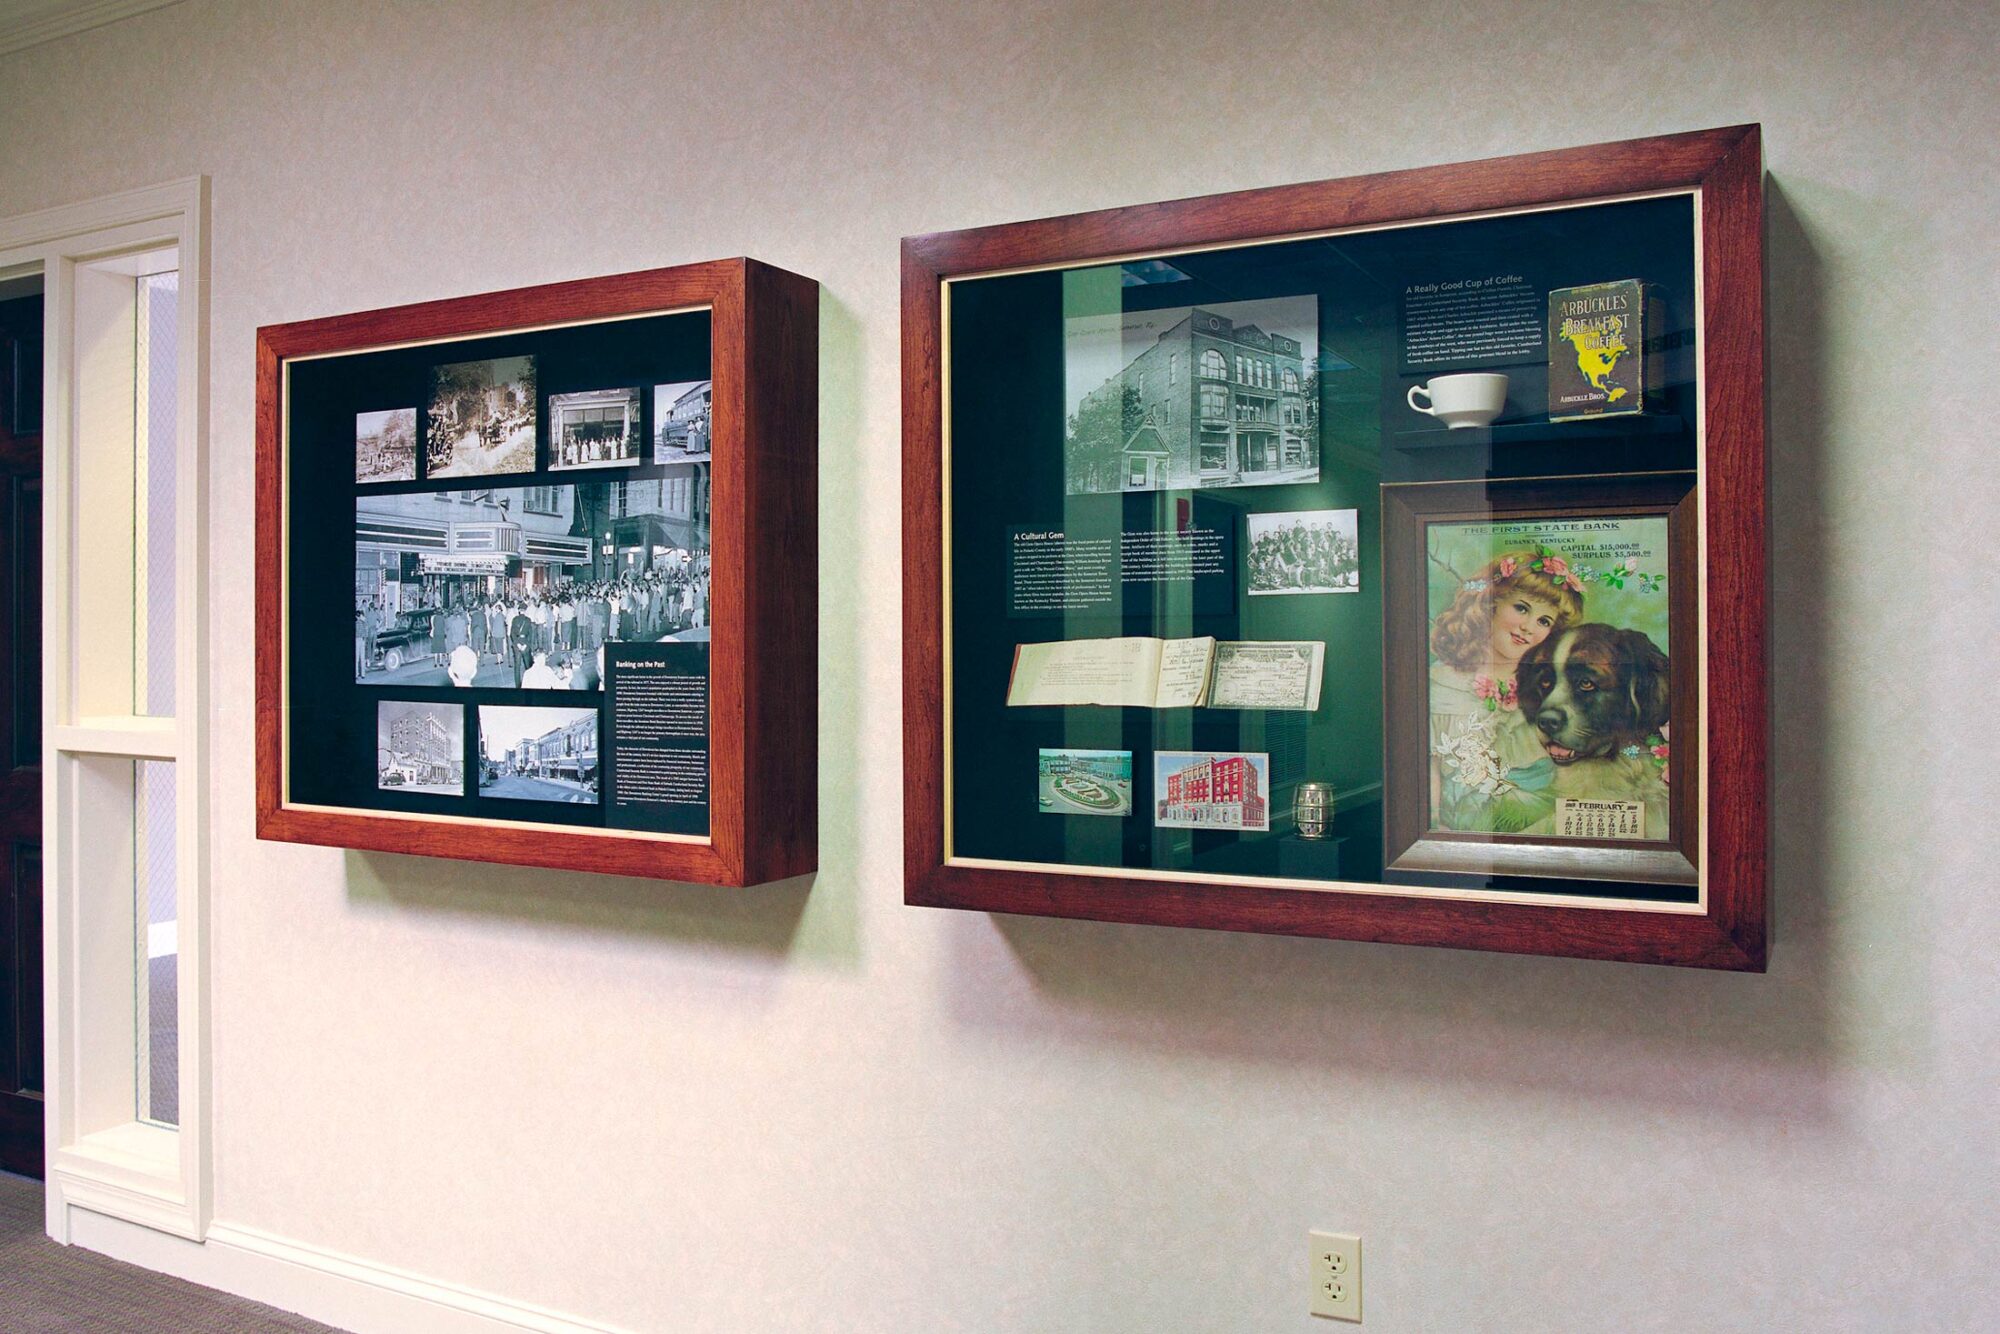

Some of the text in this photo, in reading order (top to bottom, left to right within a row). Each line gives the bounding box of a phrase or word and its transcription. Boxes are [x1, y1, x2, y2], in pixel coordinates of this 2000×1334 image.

[1415, 284, 1439, 293] Really
[1441, 281, 1463, 290] Good
[1466, 280, 1482, 288] Cup
[1484, 277, 1494, 285] of
[1496, 275, 1523, 284] Coffee
[1565, 314, 1630, 336] BREAKFAST
[1585, 334, 1626, 350] COFFEE
[1560, 394, 1588, 403] ARBUCKLE
[1020, 532, 1046, 540] Cultural
[1572, 551, 1611, 559] SURPLUS
